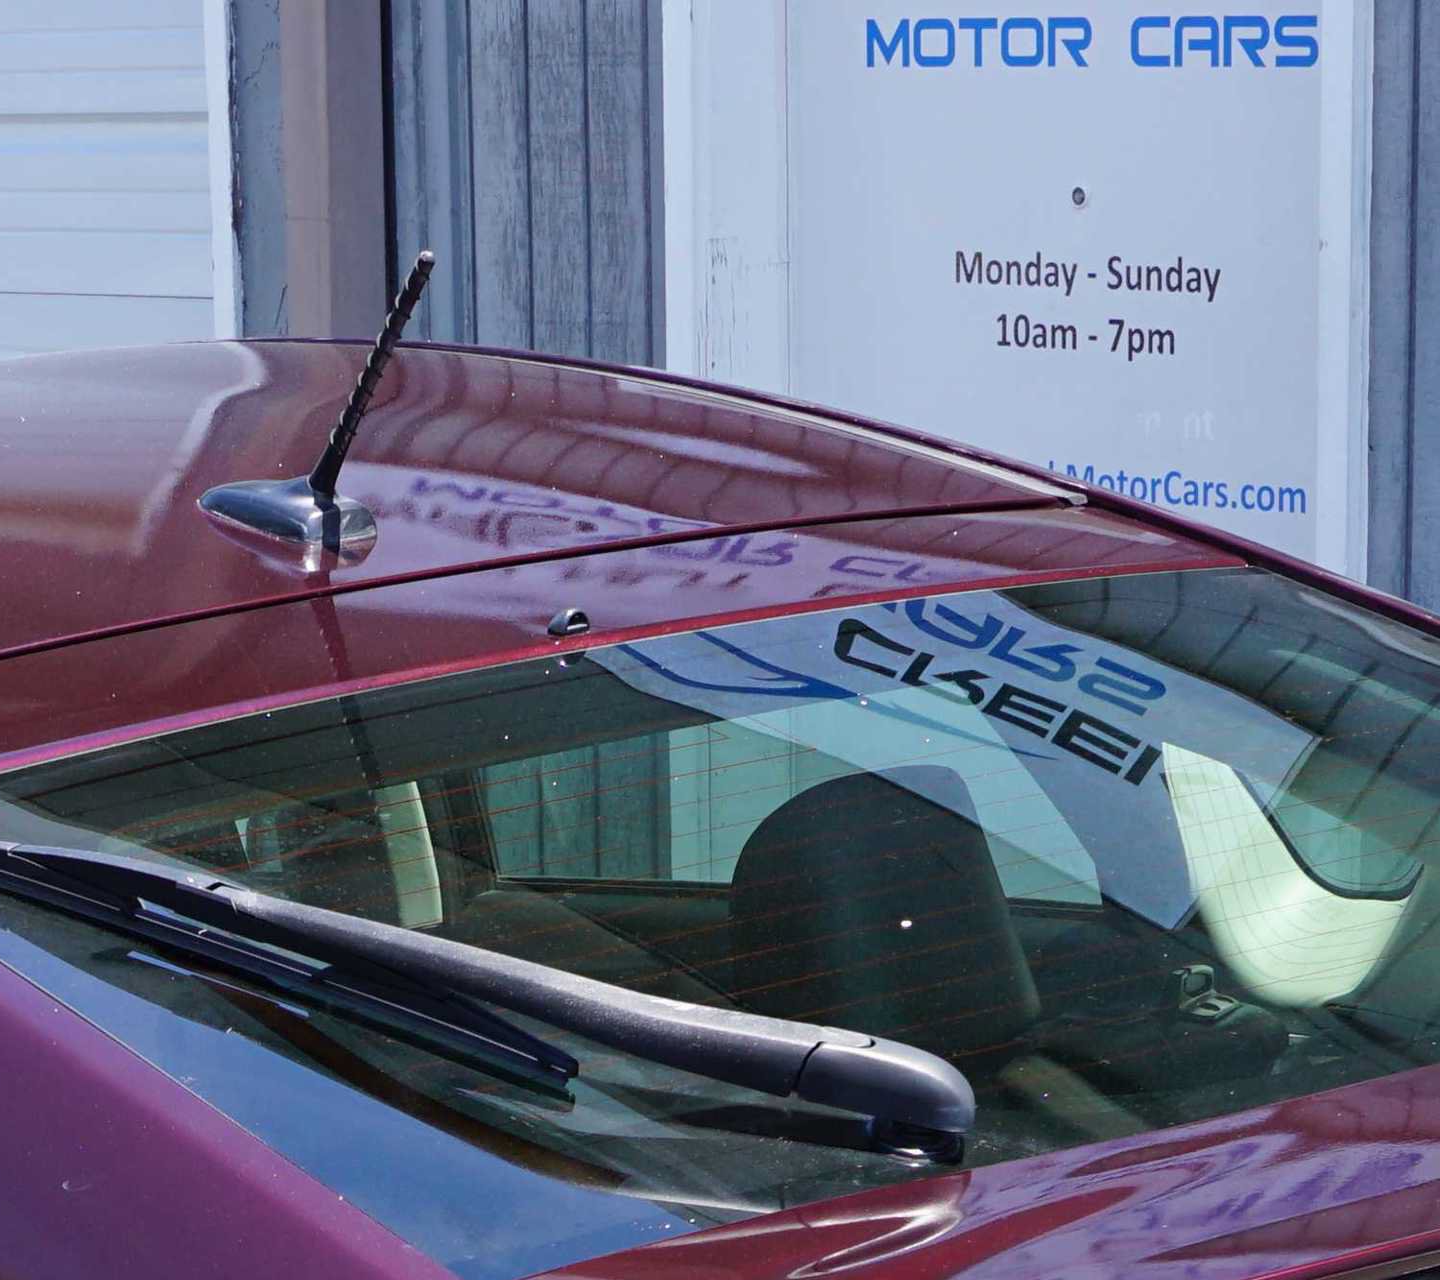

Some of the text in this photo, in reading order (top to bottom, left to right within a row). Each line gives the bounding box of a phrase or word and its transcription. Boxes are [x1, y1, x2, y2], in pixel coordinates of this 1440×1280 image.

[865, 15, 1320, 69] MOTOR CARS
[954, 250, 1078, 297] Monday
[1106, 255, 1222, 303] Sunday
[995, 313, 1079, 351] 10am
[1107, 318, 1177, 363] 7pm
